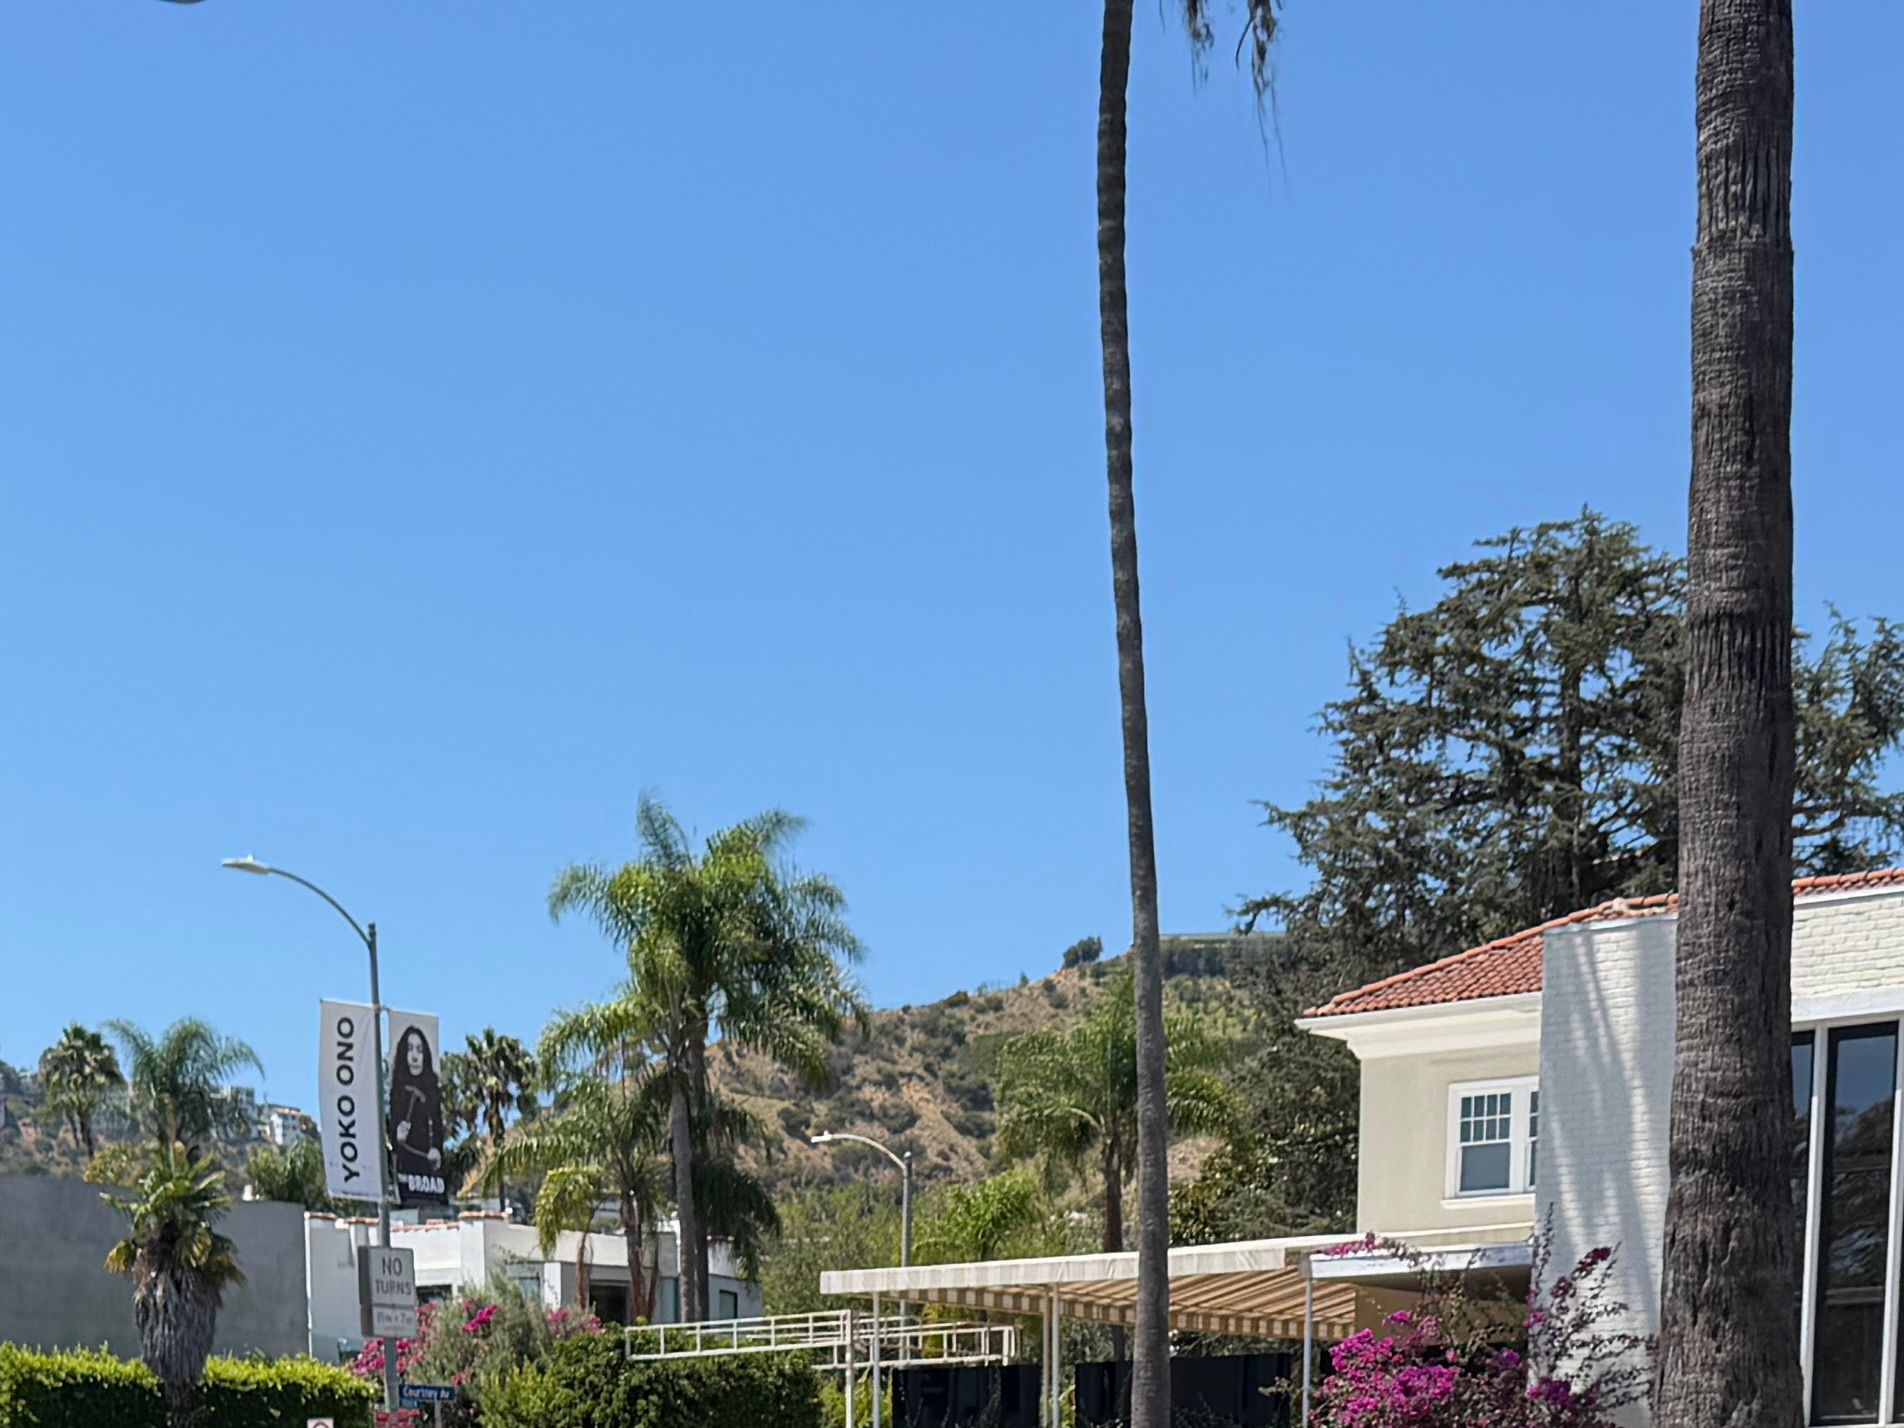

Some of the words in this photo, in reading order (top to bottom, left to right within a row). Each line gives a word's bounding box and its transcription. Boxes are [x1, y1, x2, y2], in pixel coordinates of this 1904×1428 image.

[336, 1016, 355, 1086] ONO
[337, 1094, 361, 1183] YOKO
[408, 1174, 445, 1194] BROAD
[382, 1257, 402, 1277] NO
[376, 1279, 412, 1296] TURNS
